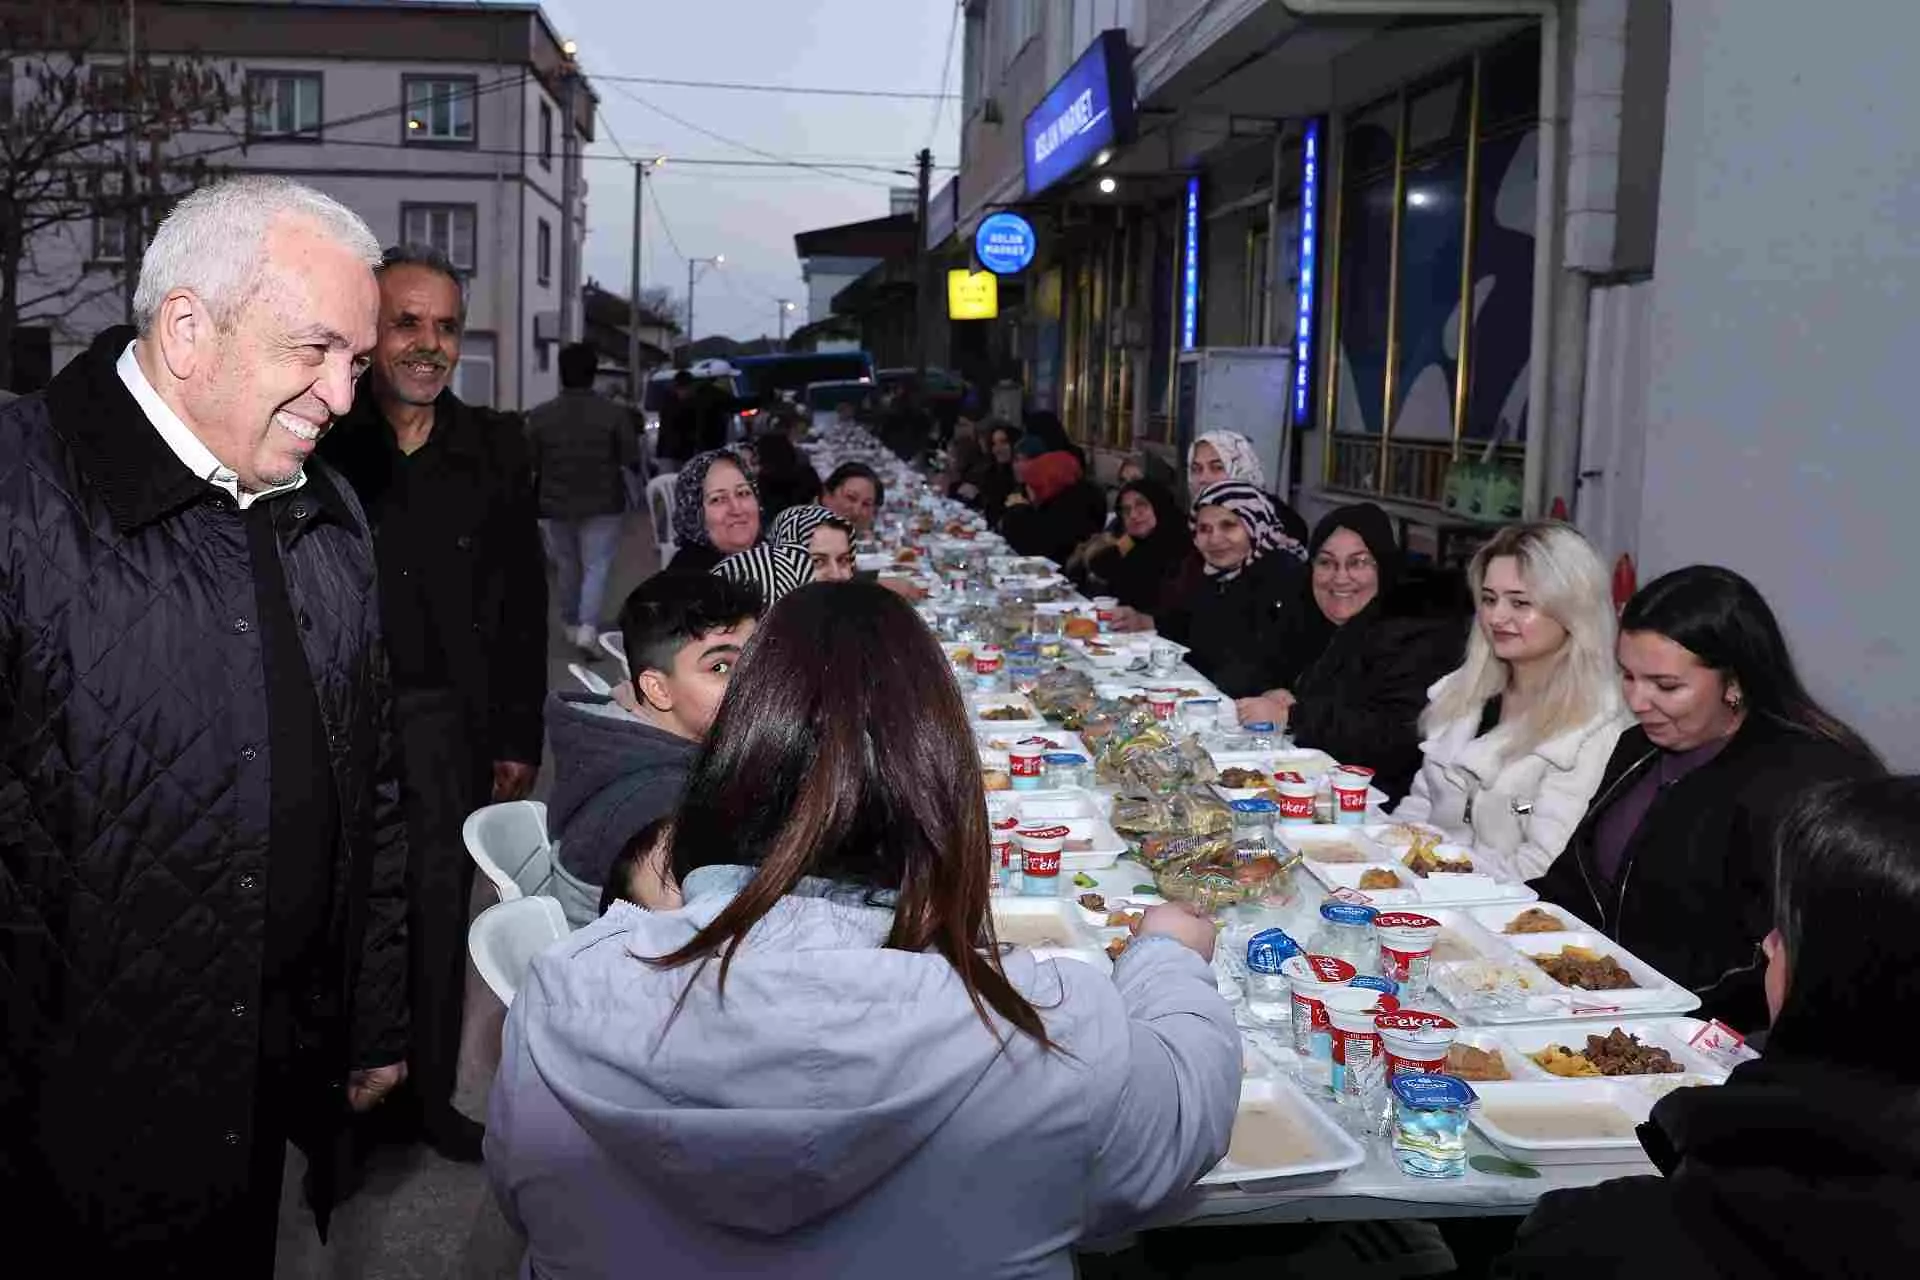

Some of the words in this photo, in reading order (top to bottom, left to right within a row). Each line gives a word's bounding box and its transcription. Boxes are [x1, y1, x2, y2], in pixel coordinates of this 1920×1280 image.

[1035, 121, 1060, 163] ASLAN
[1058, 87, 1094, 146] MARKET
[989, 233, 1024, 244] ASLAN
[1187, 192, 1197, 285] ASLAN
[1304, 137, 1315, 256] ASLAN
[983, 244, 1025, 256] MARKET
[1298, 268, 1312, 410] MARKET
